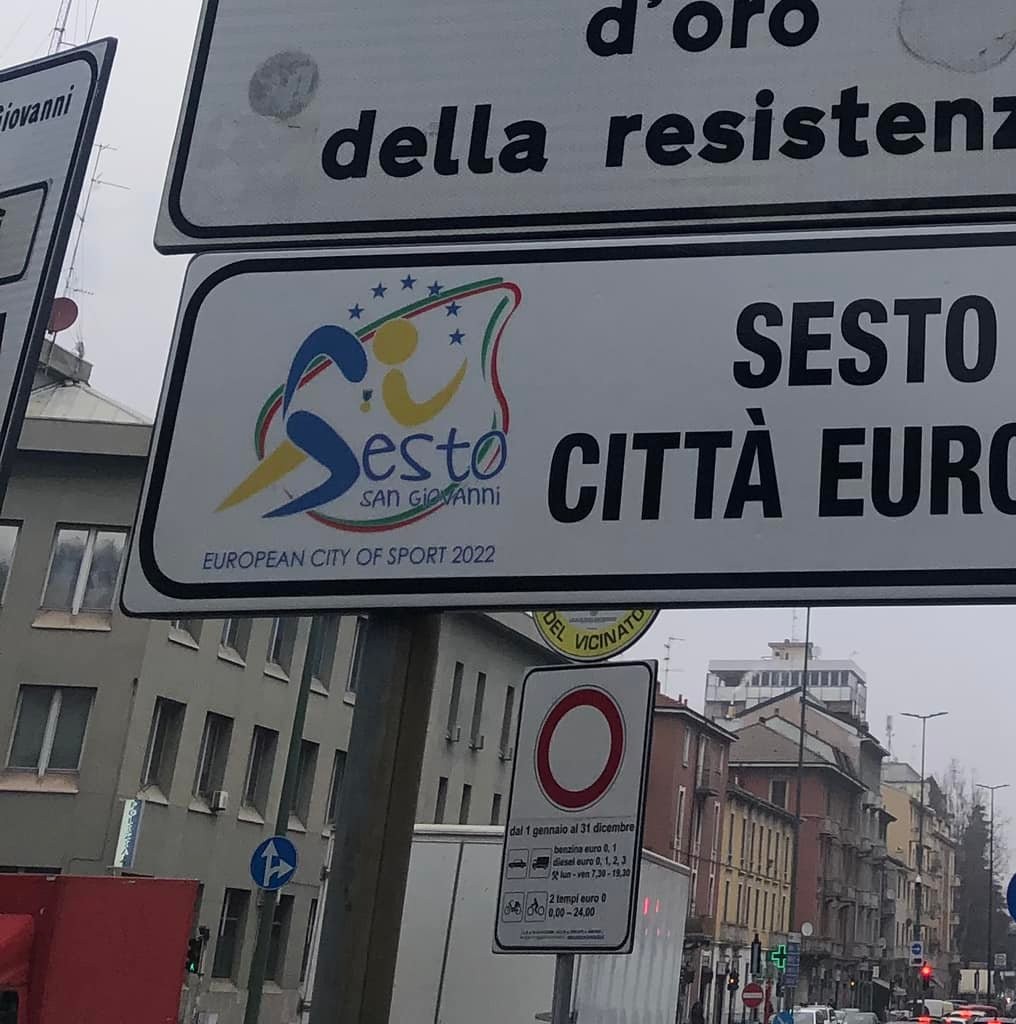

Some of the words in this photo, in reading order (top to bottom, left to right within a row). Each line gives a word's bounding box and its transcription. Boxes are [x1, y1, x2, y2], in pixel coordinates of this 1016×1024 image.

[322, 106, 548, 180] della
[733, 295, 997, 388] SESTO
[548, 408, 782, 523] CITTÀ
[203, 550, 305, 570] EUROPEAN
[311, 548, 351, 568] CITY
[356, 548, 383, 566] OF
[387, 546, 447, 565] SPORT
[452, 545, 495, 564] 2022
[543, 609, 566, 642] DEL
[575, 608, 644, 650] VICINATO
[510, 826, 523, 836] dal
[526, 825, 530, 835] 1
[533, 824, 568, 837] gennaio
[570, 824, 578, 834] al
[580, 823, 591, 833] 31
[593, 822, 635, 833] dicembre
[580, 895, 599, 903] euro
